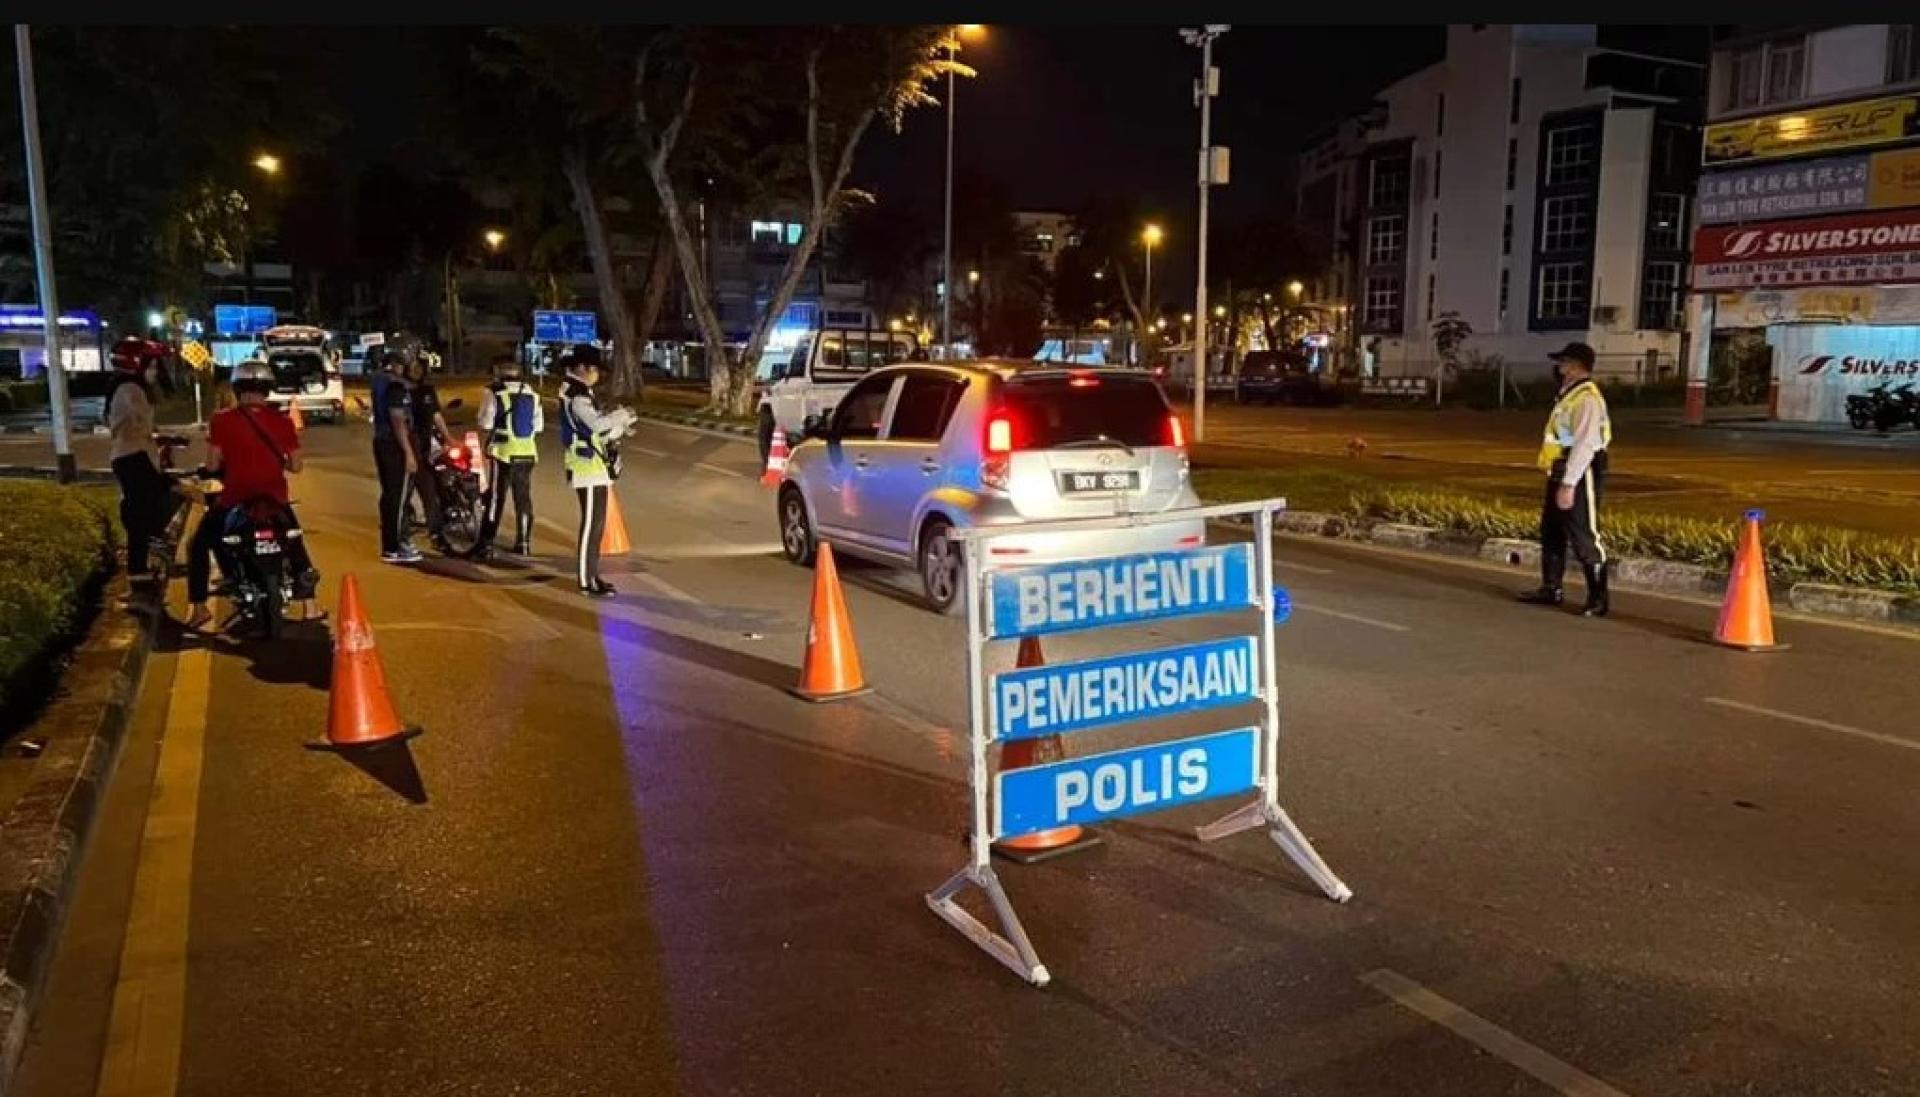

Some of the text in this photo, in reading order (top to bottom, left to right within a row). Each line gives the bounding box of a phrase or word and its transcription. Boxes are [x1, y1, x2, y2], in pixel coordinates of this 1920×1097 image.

[1765, 223, 1920, 253] SILVERSTONE
[1019, 554, 1225, 627] BERHENTI
[1002, 648, 1247, 732] PEMERIKSAAN
[1055, 748, 1208, 822] POLIS
